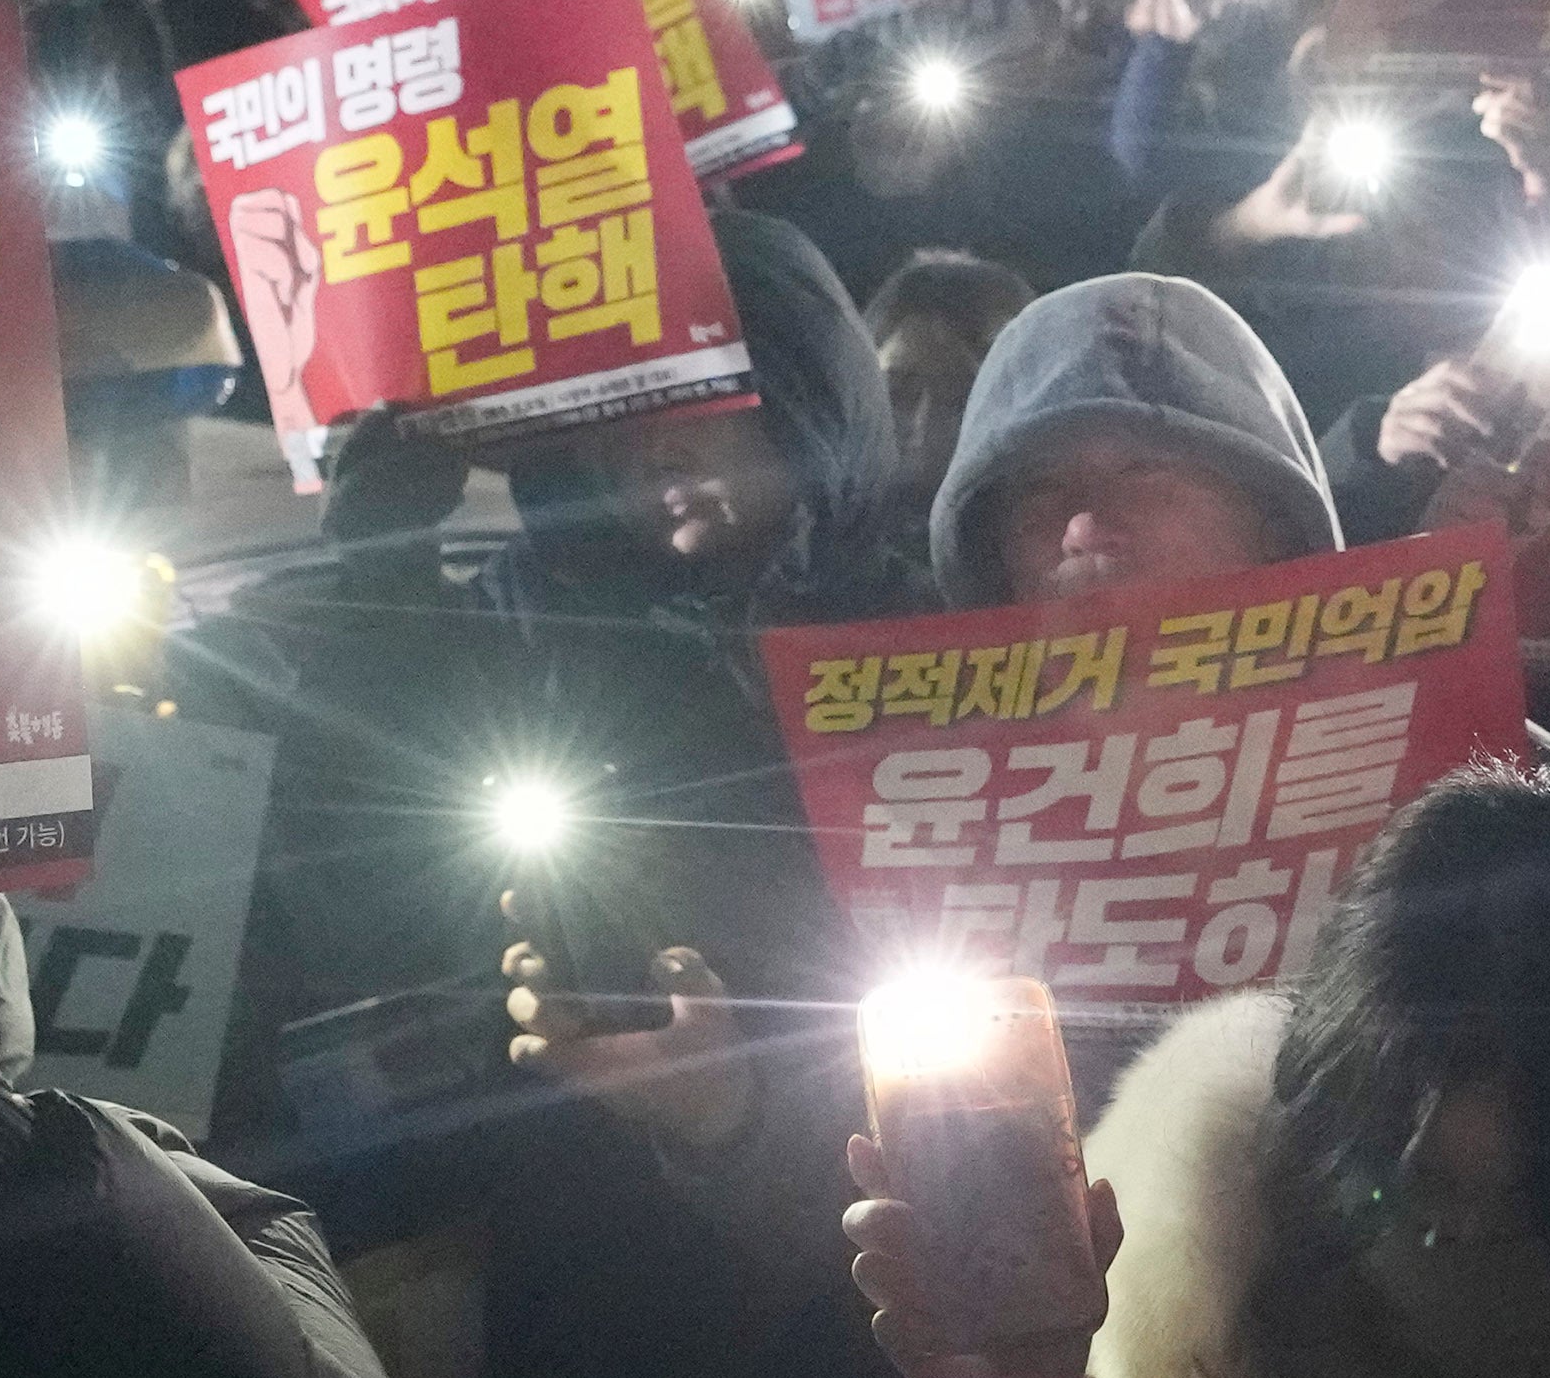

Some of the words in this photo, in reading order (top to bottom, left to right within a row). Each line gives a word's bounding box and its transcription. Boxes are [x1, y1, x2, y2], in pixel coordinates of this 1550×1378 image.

[200, 57, 327, 171] 국민의
[331, 16, 465, 133] 명령
[312, 66, 654, 286] 윤석열
[412, 205, 664, 399] 탄핵
[802, 624, 1129, 735] 정적제거
[1143, 559, 1488, 697] 국민억압
[16, 818, 67, 850] 가능)
[857, 679, 1420, 872] 윤건희를
